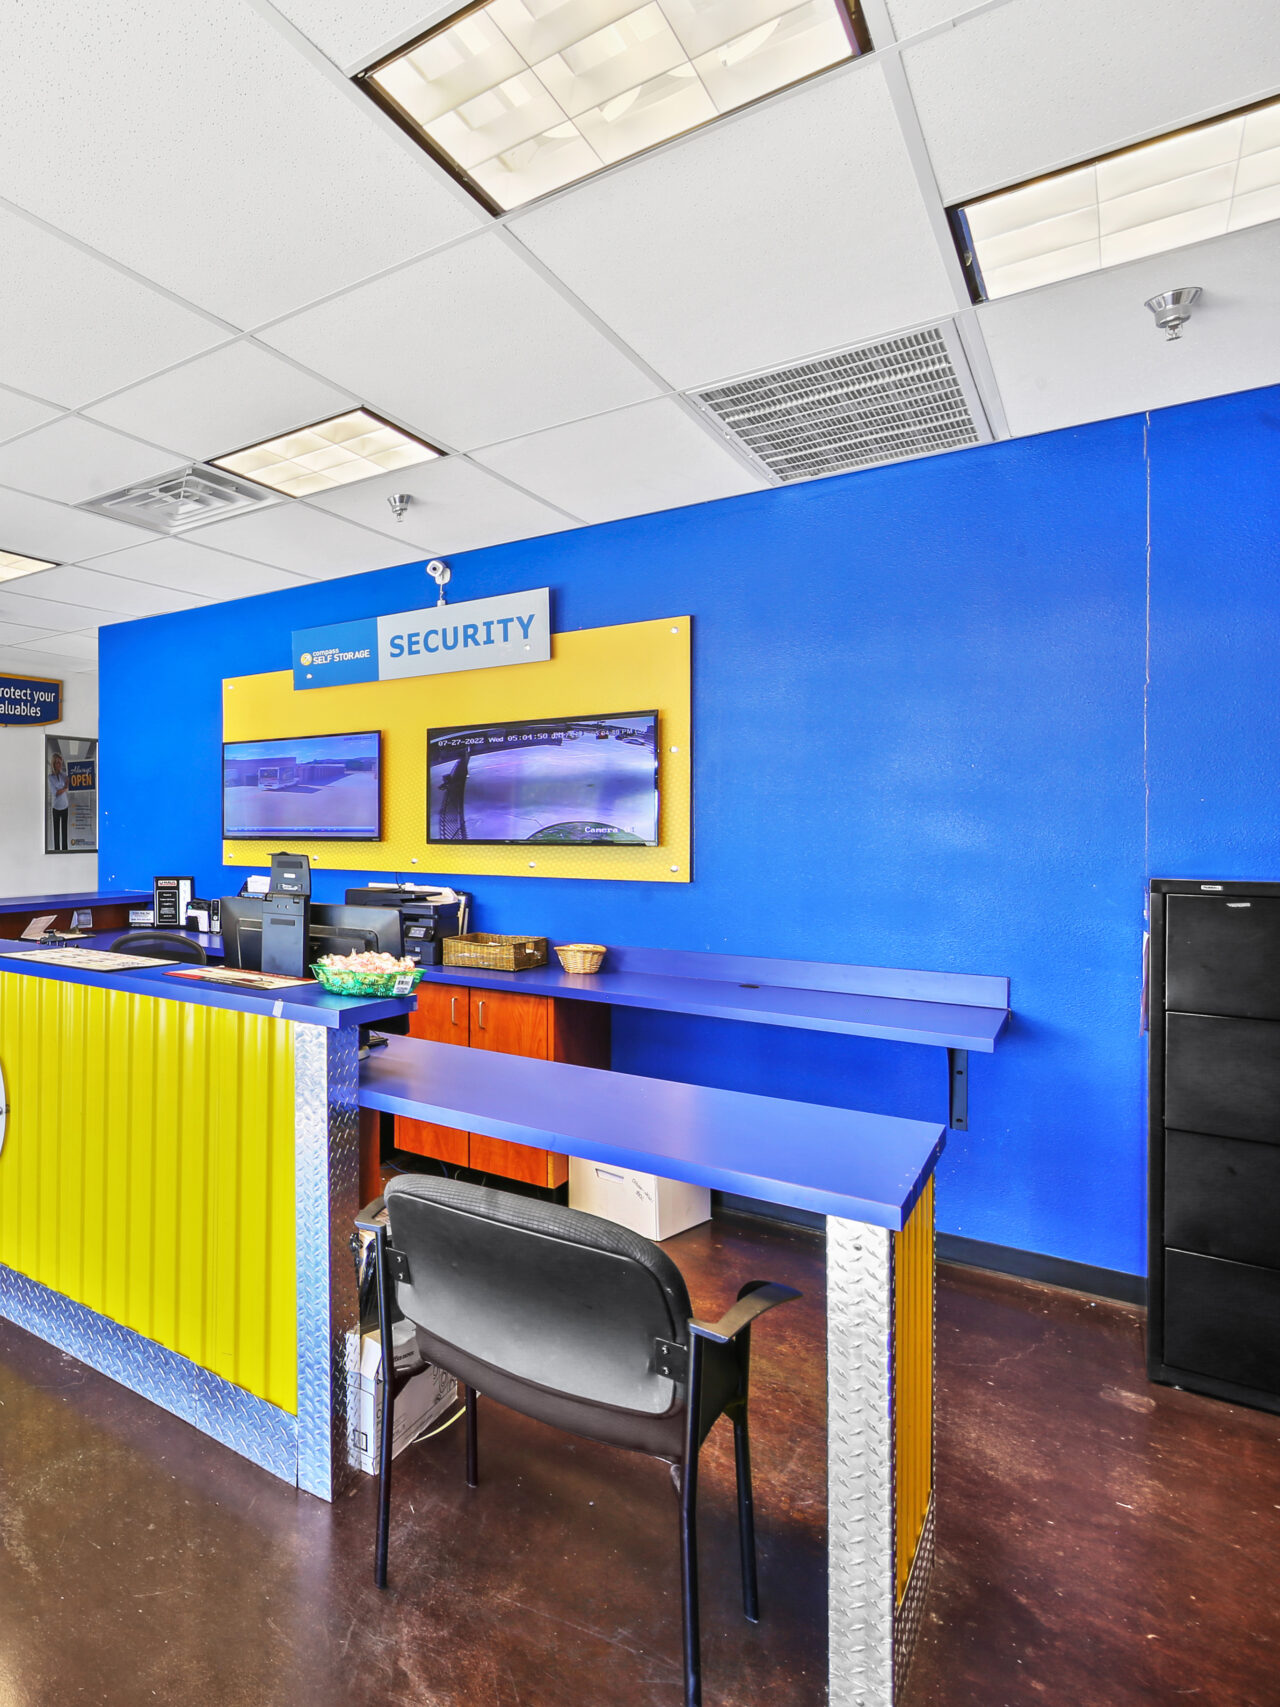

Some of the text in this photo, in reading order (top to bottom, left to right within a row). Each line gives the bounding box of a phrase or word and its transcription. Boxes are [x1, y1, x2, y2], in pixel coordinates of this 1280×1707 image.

[389, 614, 535, 658] SECURITY
[313, 648, 339, 656] compass
[313, 649, 370, 664] SELF STORAGE
[33, 690, 56, 704] your
[438, 737, 484, 747] 07-27-2022
[71, 774, 92, 787] OPEN
